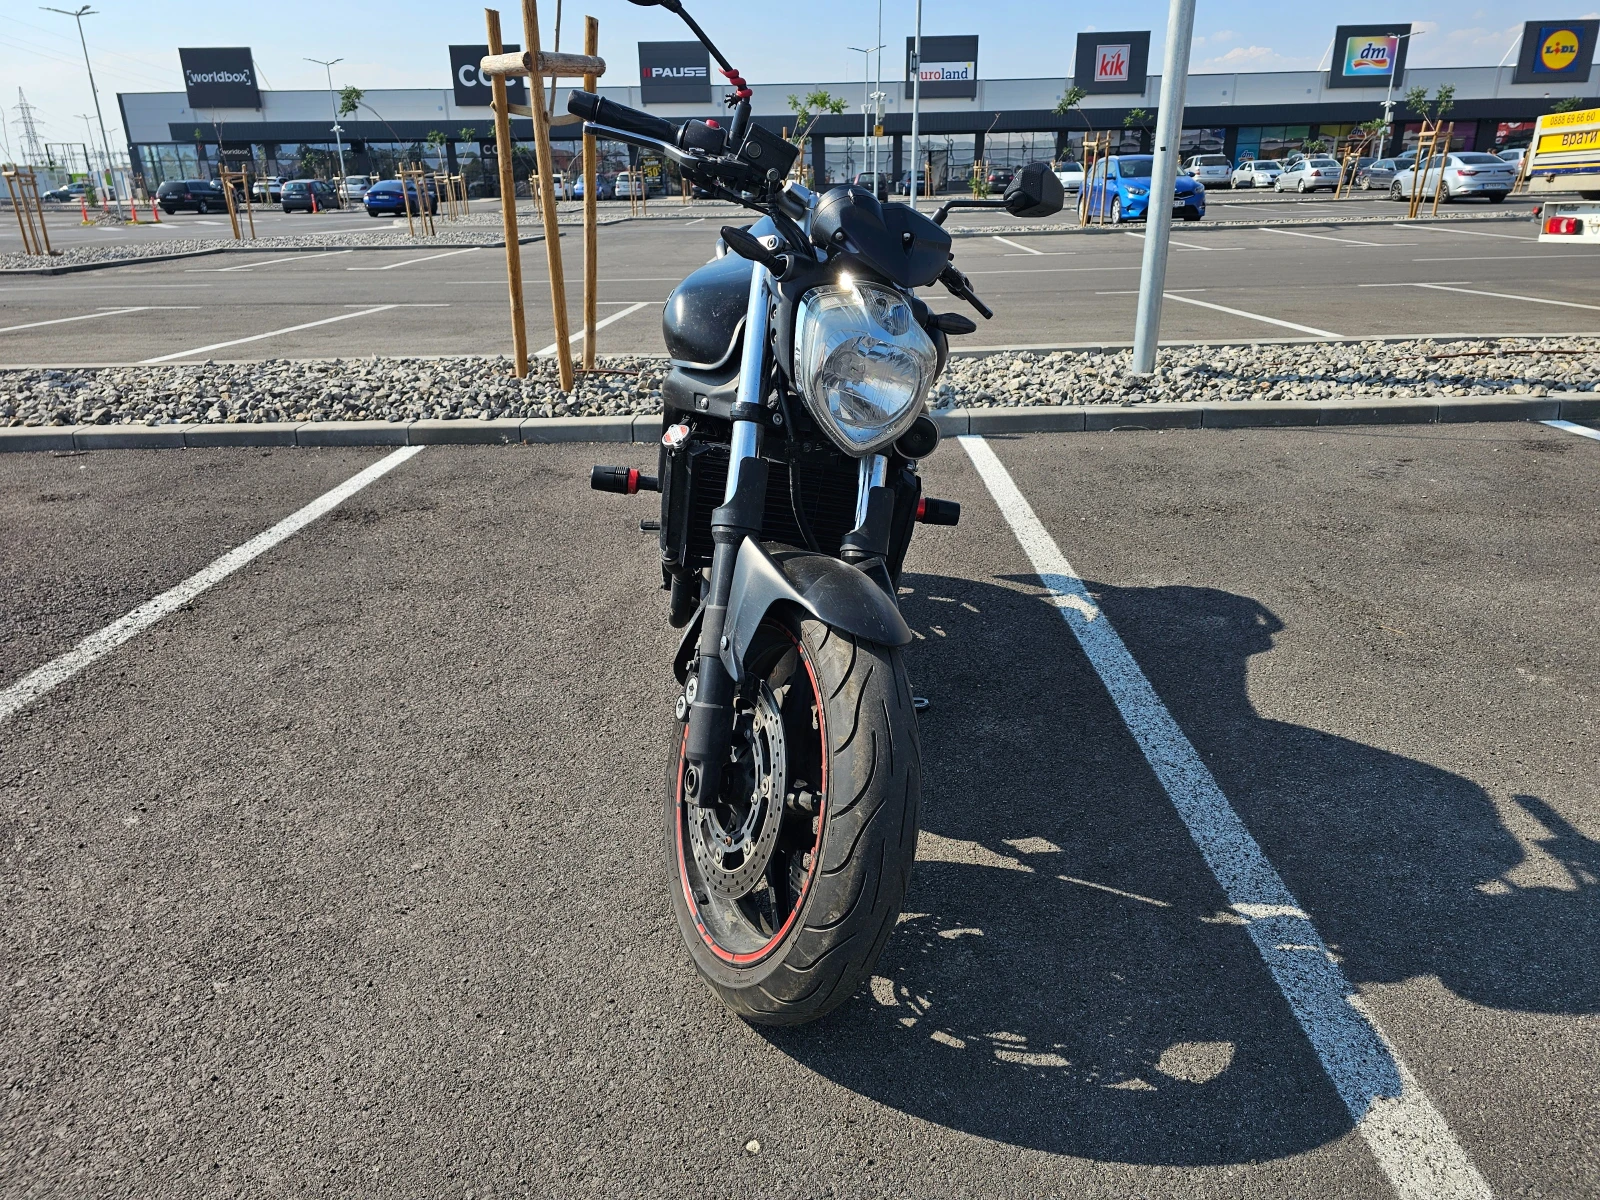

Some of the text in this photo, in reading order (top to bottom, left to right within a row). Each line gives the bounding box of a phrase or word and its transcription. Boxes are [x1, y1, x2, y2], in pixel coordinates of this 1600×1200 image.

[1360, 43, 1387, 59] dm
[190, 71, 248, 83] worldbox
[458, 64, 517, 87] CC
[651, 66, 707, 78] PAUSE
[913, 67, 969, 80] uroland
